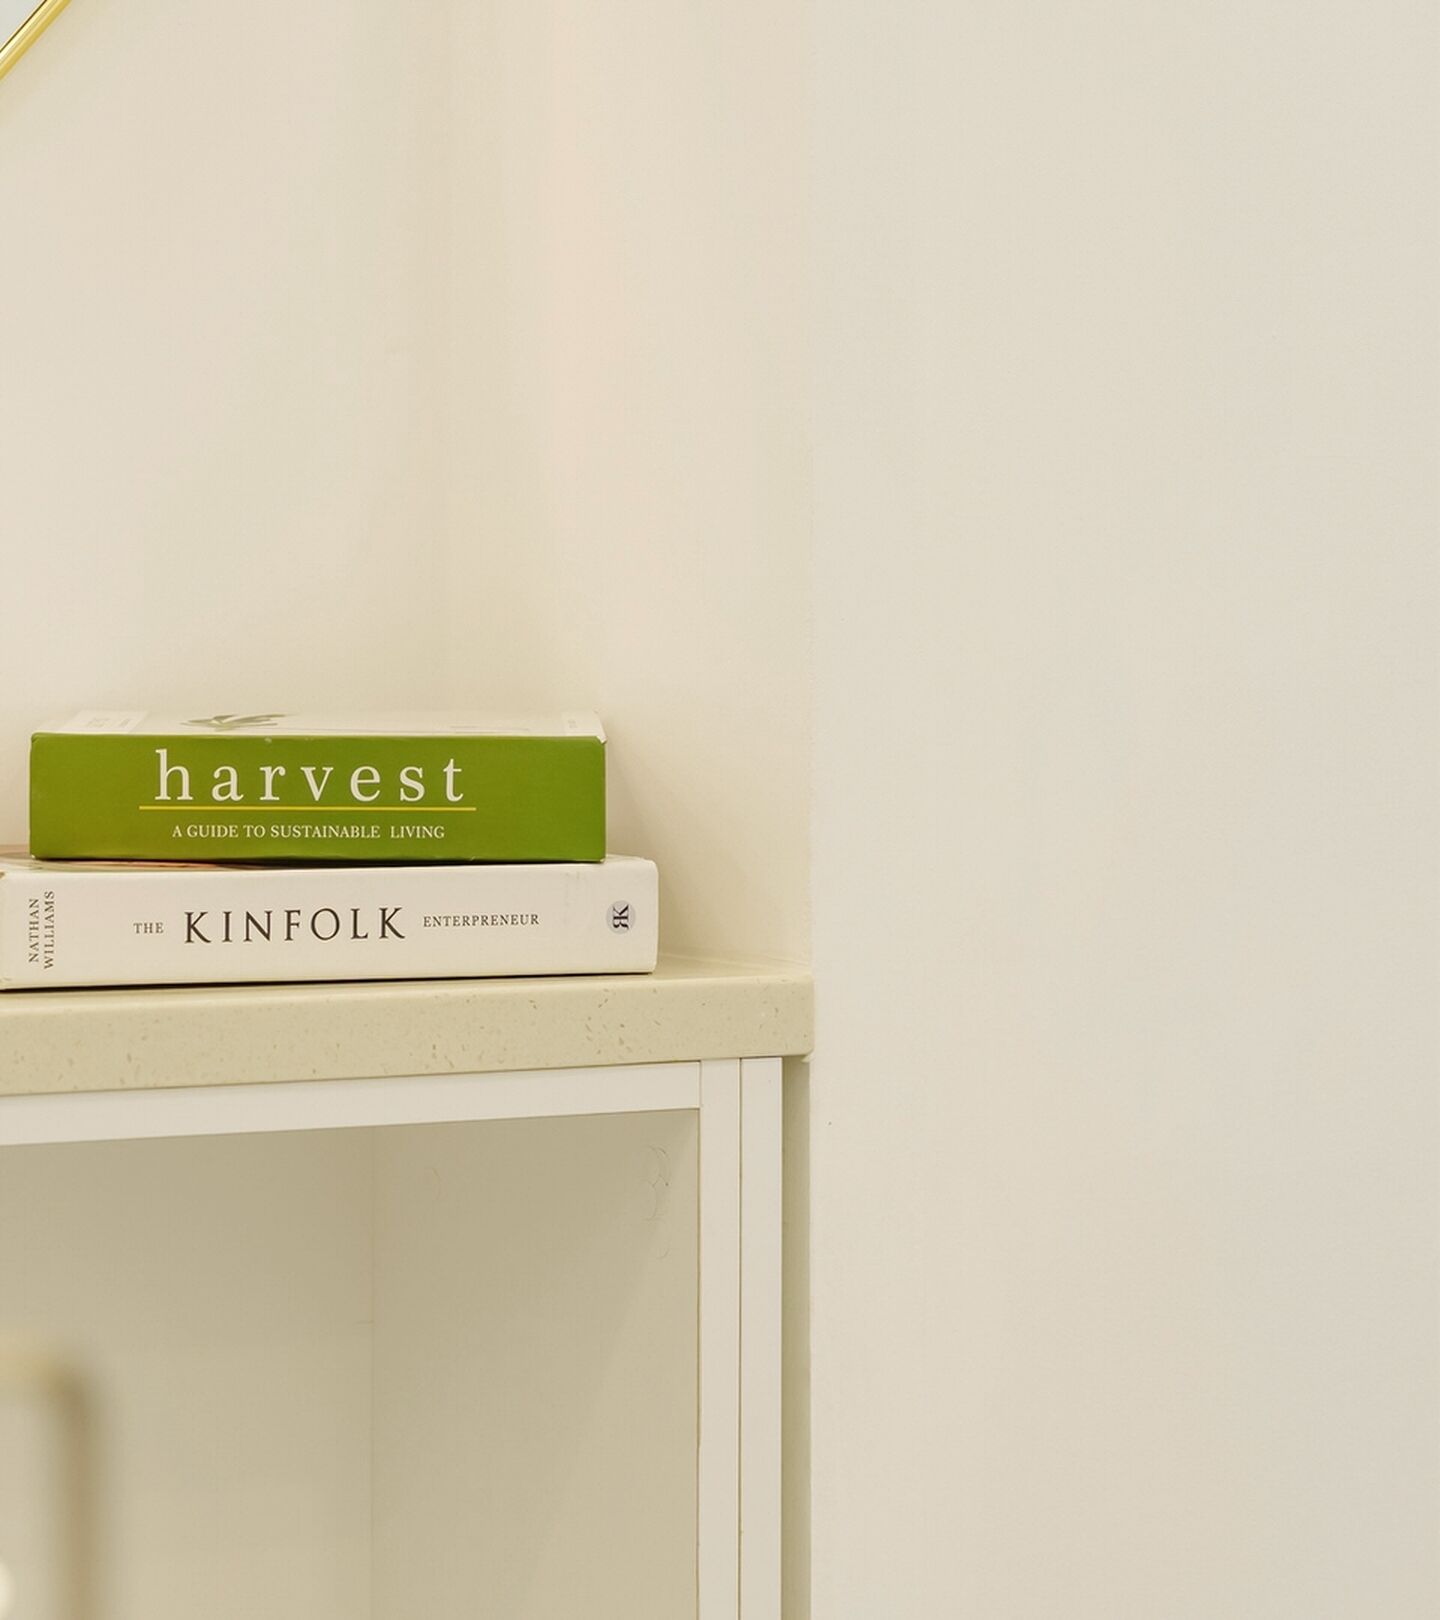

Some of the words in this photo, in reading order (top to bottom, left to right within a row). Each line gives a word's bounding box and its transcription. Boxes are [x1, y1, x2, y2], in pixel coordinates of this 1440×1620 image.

[154, 748, 464, 802] harvest
[172, 825, 183, 838] A
[186, 824, 239, 839] GUIDE
[243, 824, 266, 838] TO
[270, 824, 381, 839] SUSTAINABLE
[390, 825, 445, 839] LIVING
[28, 898, 40, 963] NATHAN
[43, 890, 56, 970] WILLIAMS
[132, 922, 165, 934] THE
[184, 907, 405, 944] KINFOLK
[422, 913, 540, 928] ENTERPRENEUR
